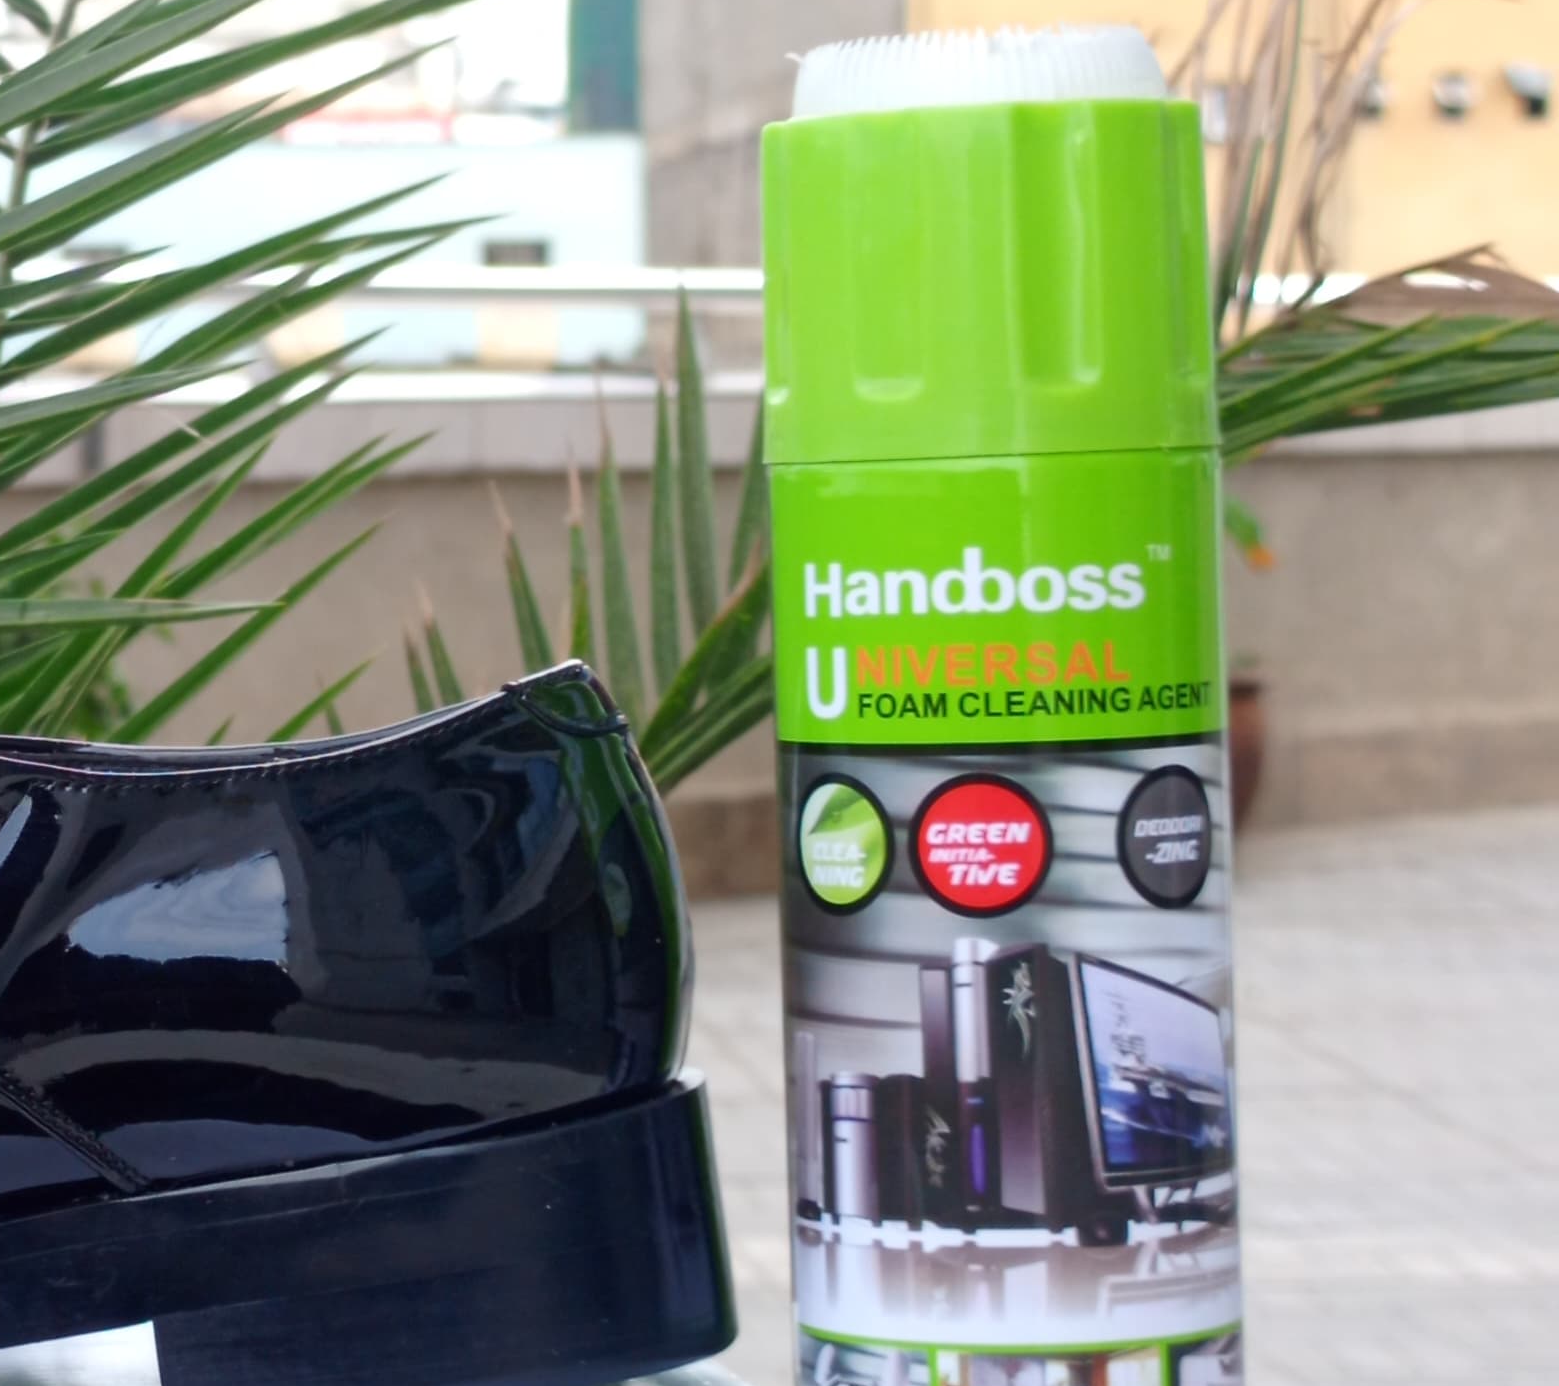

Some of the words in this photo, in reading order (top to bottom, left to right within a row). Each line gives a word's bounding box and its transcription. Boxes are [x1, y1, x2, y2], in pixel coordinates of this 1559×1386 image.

[804, 547, 1146, 618] Handboss
[805, 639, 1132, 721] UNIVERSAL
[857, 692, 948, 719] FOAM
[958, 686, 1131, 718] CLEANING
[1137, 681, 1212, 712] AGENT
[926, 822, 1031, 845] GREEN
[812, 865, 865, 889] NING
[947, 862, 1021, 887] TIVE
